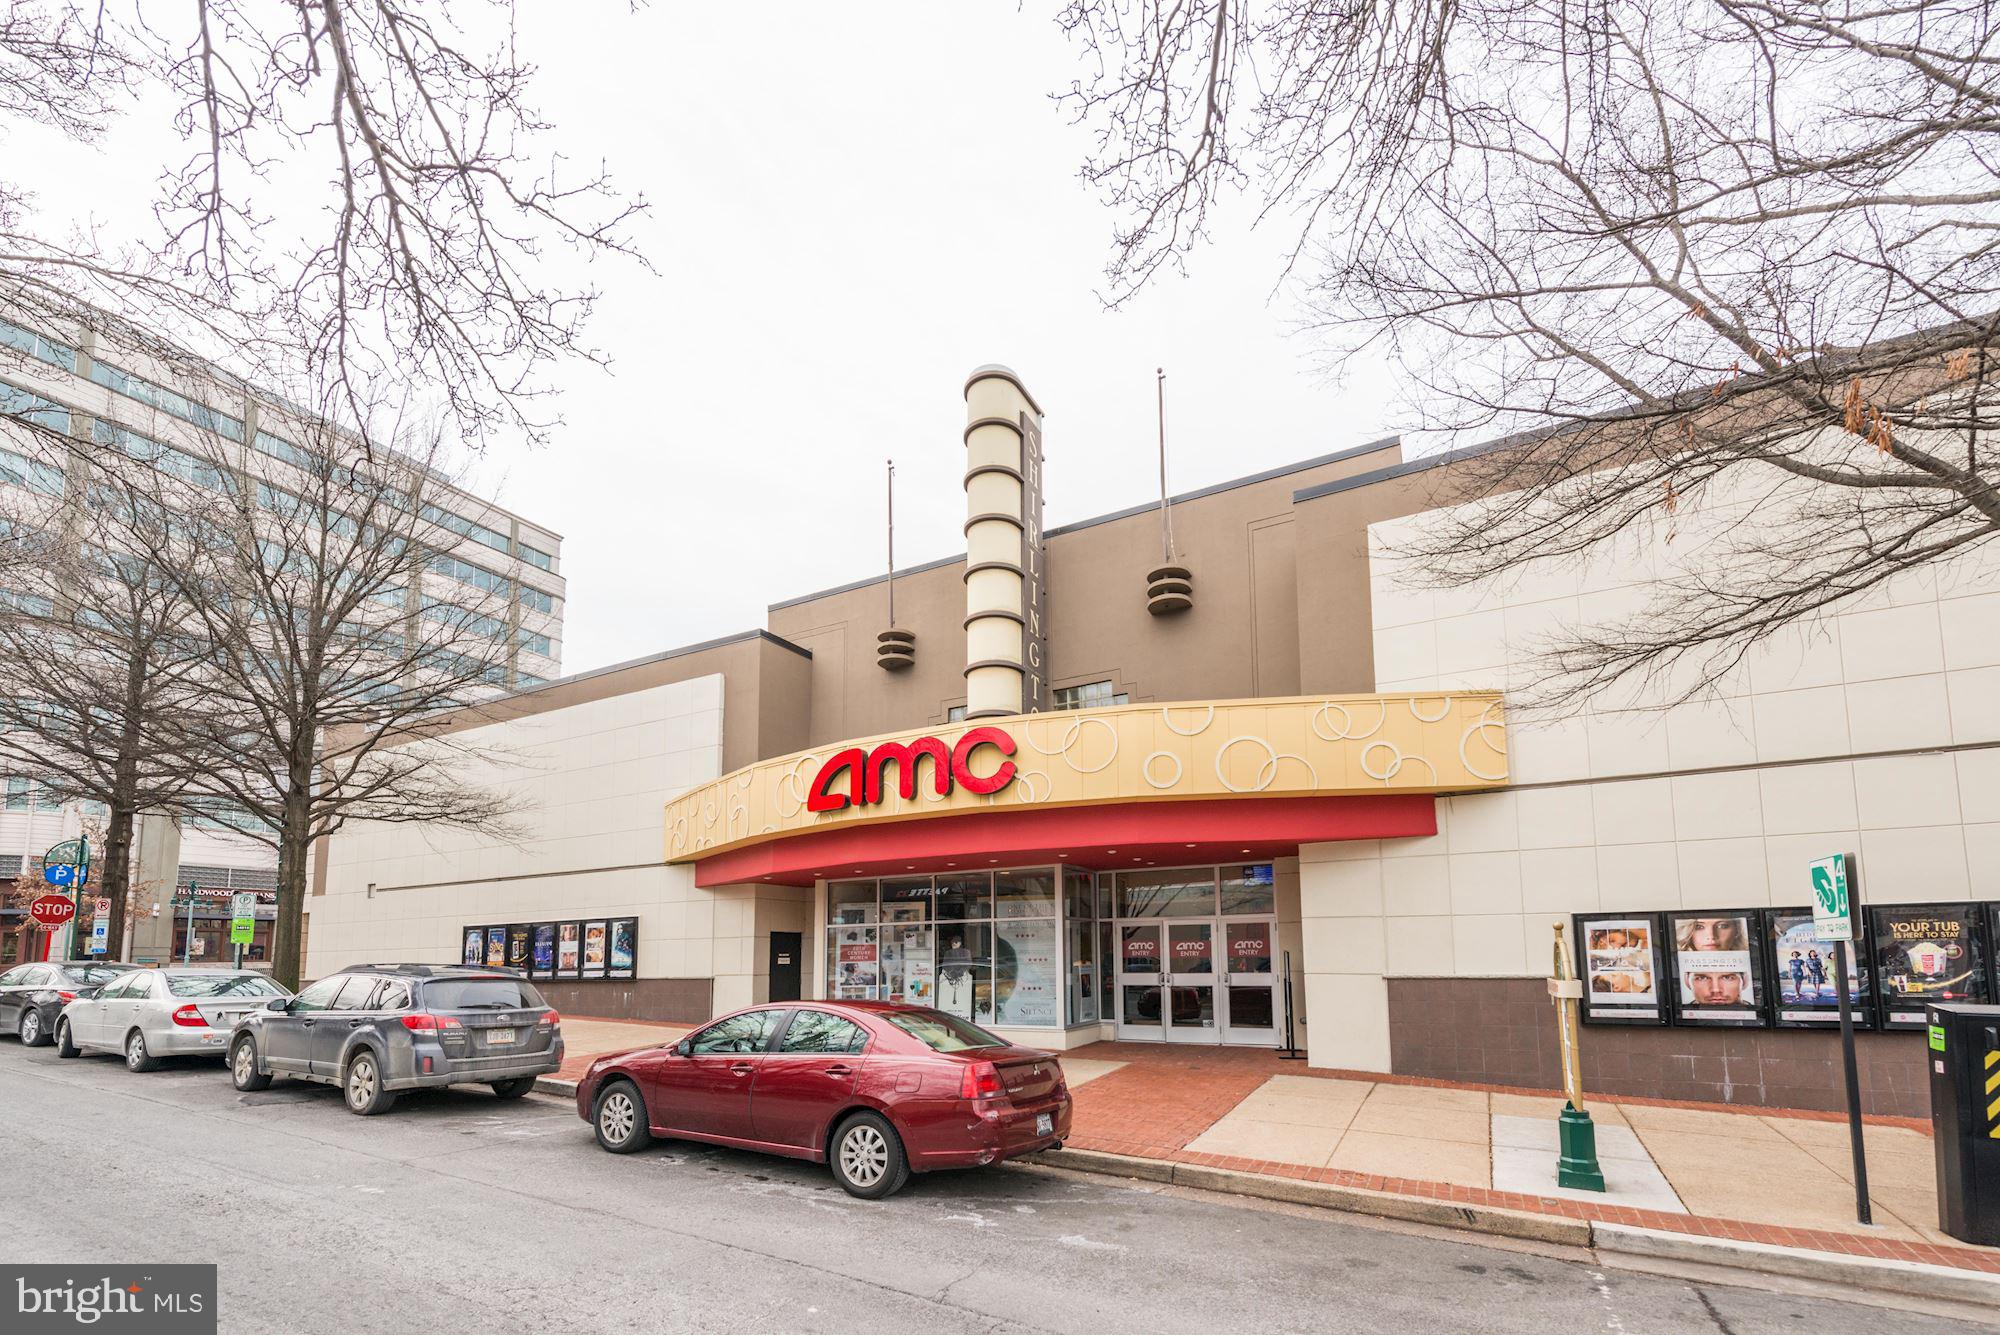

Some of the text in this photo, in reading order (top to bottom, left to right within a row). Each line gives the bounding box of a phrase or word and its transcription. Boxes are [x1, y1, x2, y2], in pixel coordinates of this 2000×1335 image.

[1027, 430, 1041, 714] SHIRLINGT
[1835, 859, 1845, 880] 4
[33, 903, 73, 916] STOP
[1889, 921, 1961, 932] YOUR TUB
